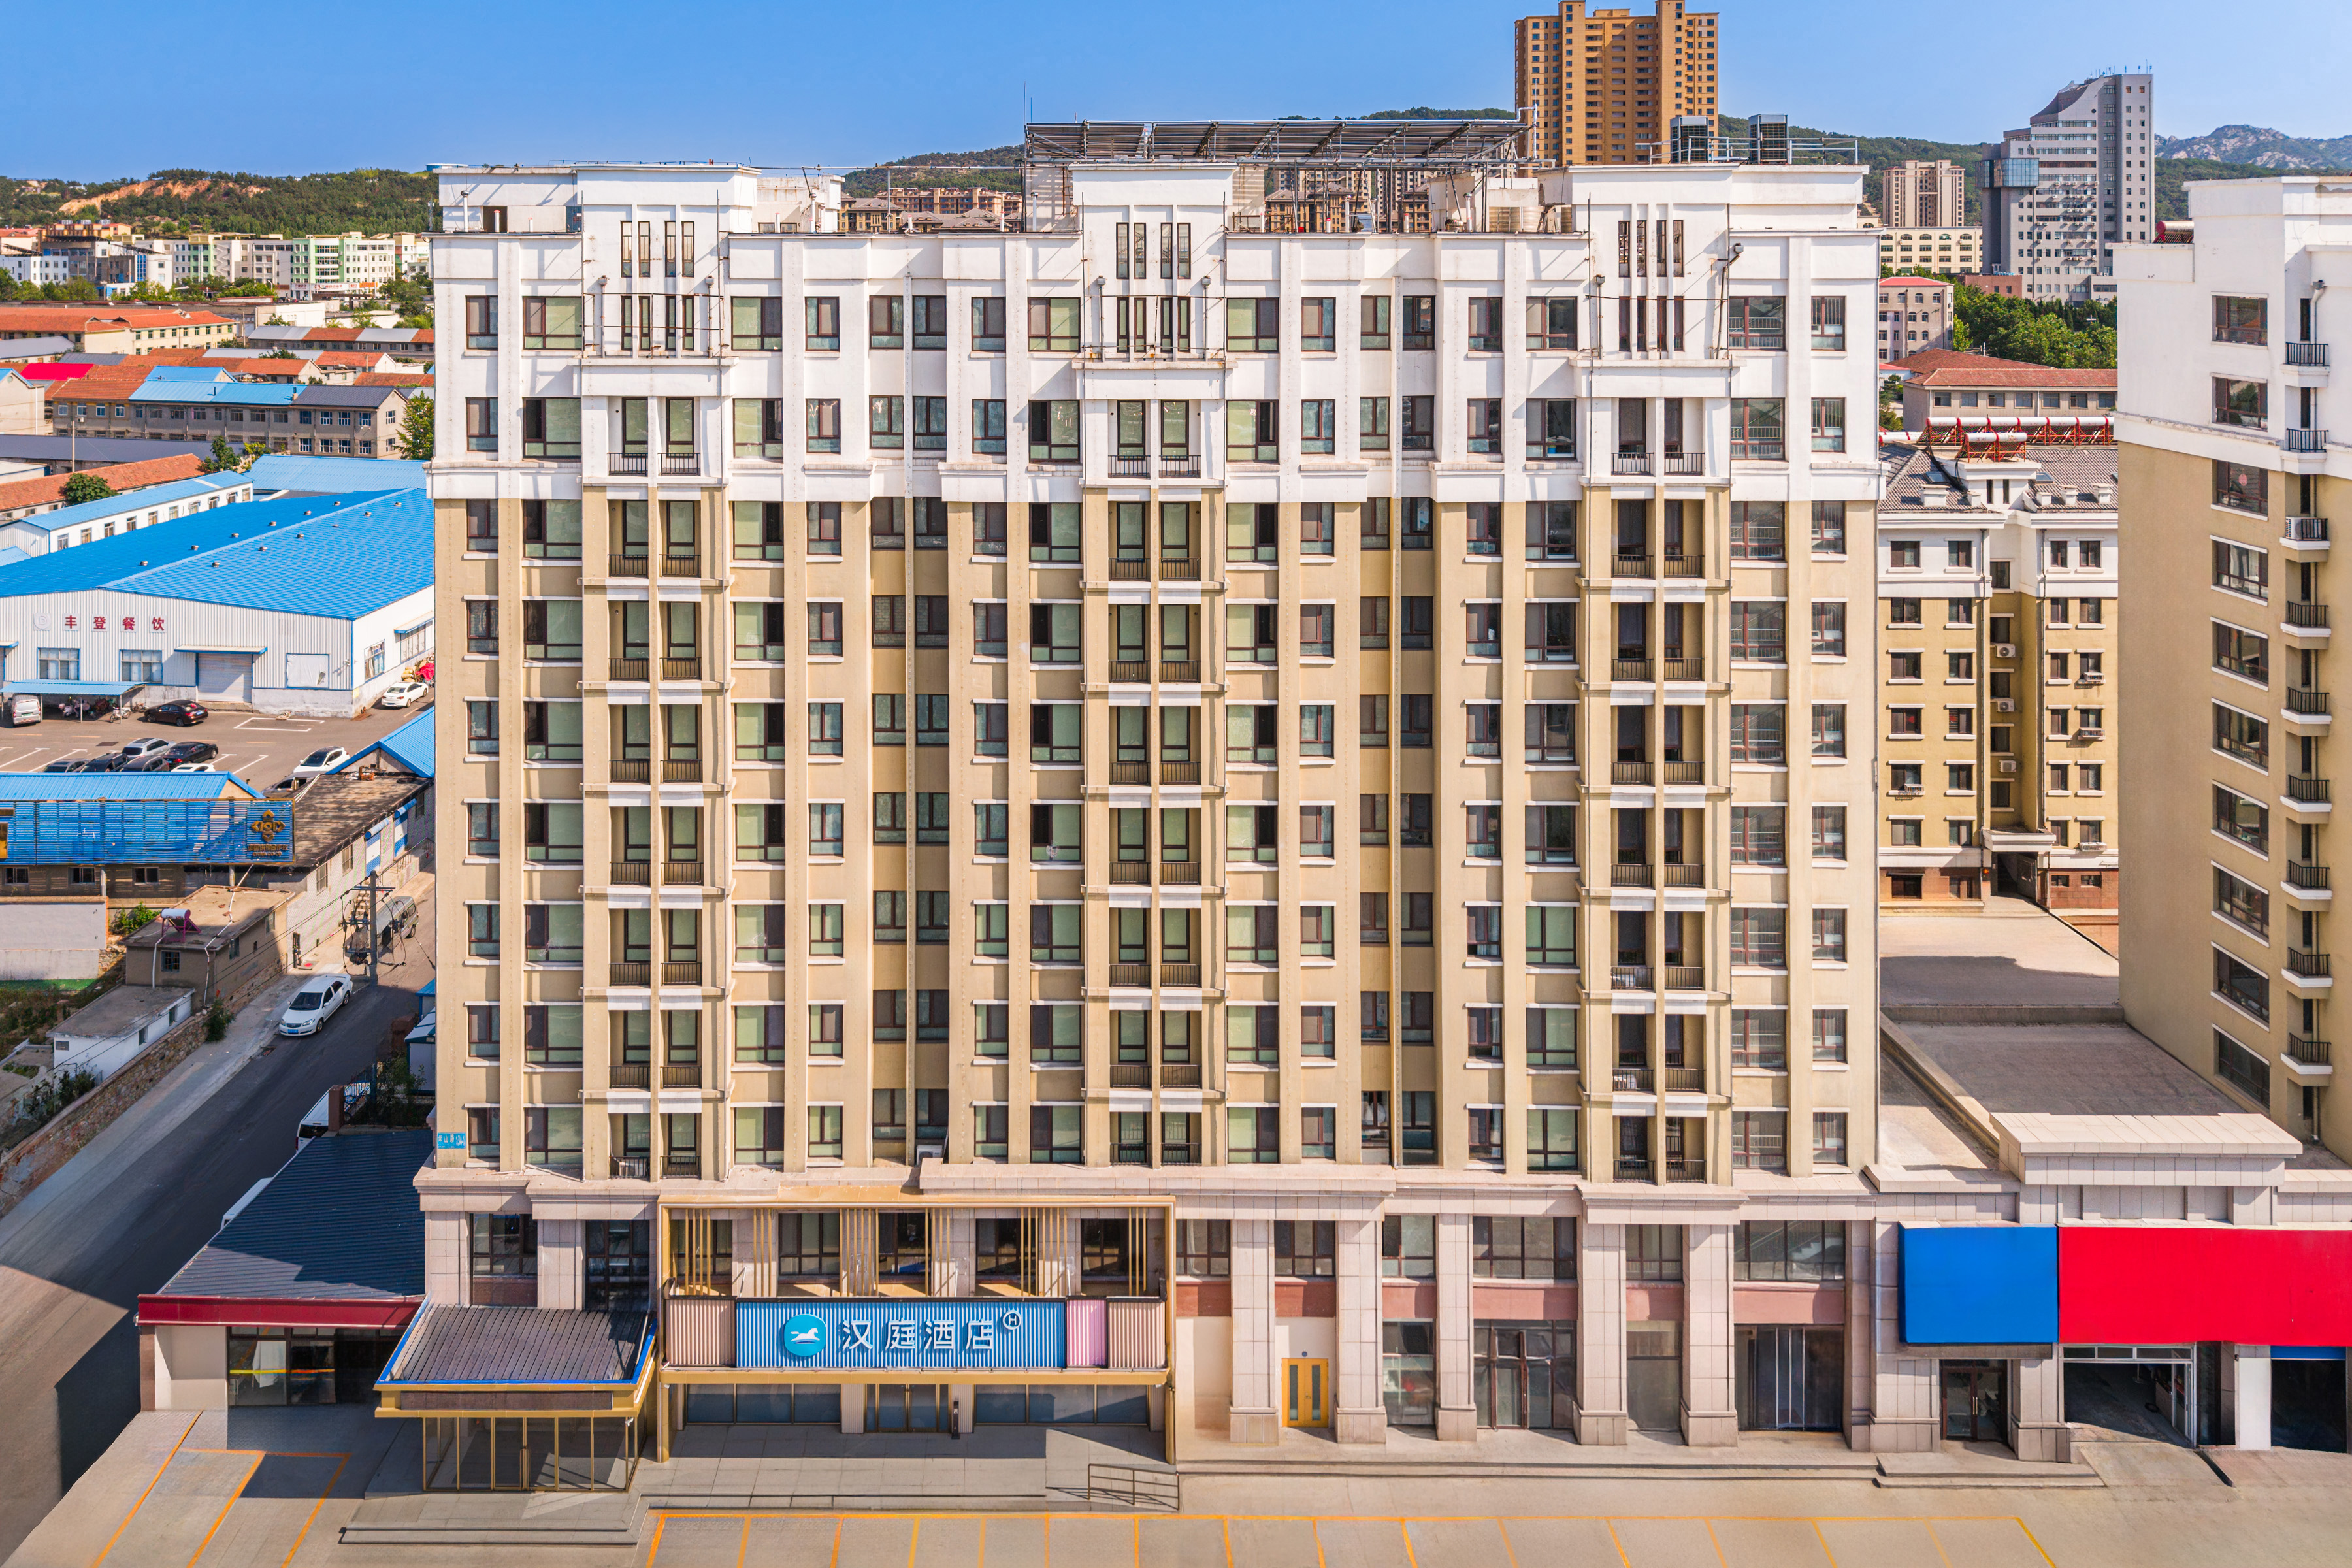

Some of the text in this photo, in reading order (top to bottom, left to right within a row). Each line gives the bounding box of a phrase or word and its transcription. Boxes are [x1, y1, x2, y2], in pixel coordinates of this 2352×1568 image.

[65, 615, 165, 631] 丰登餐饮
[842, 1319, 993, 1350] 汉庭酒店
